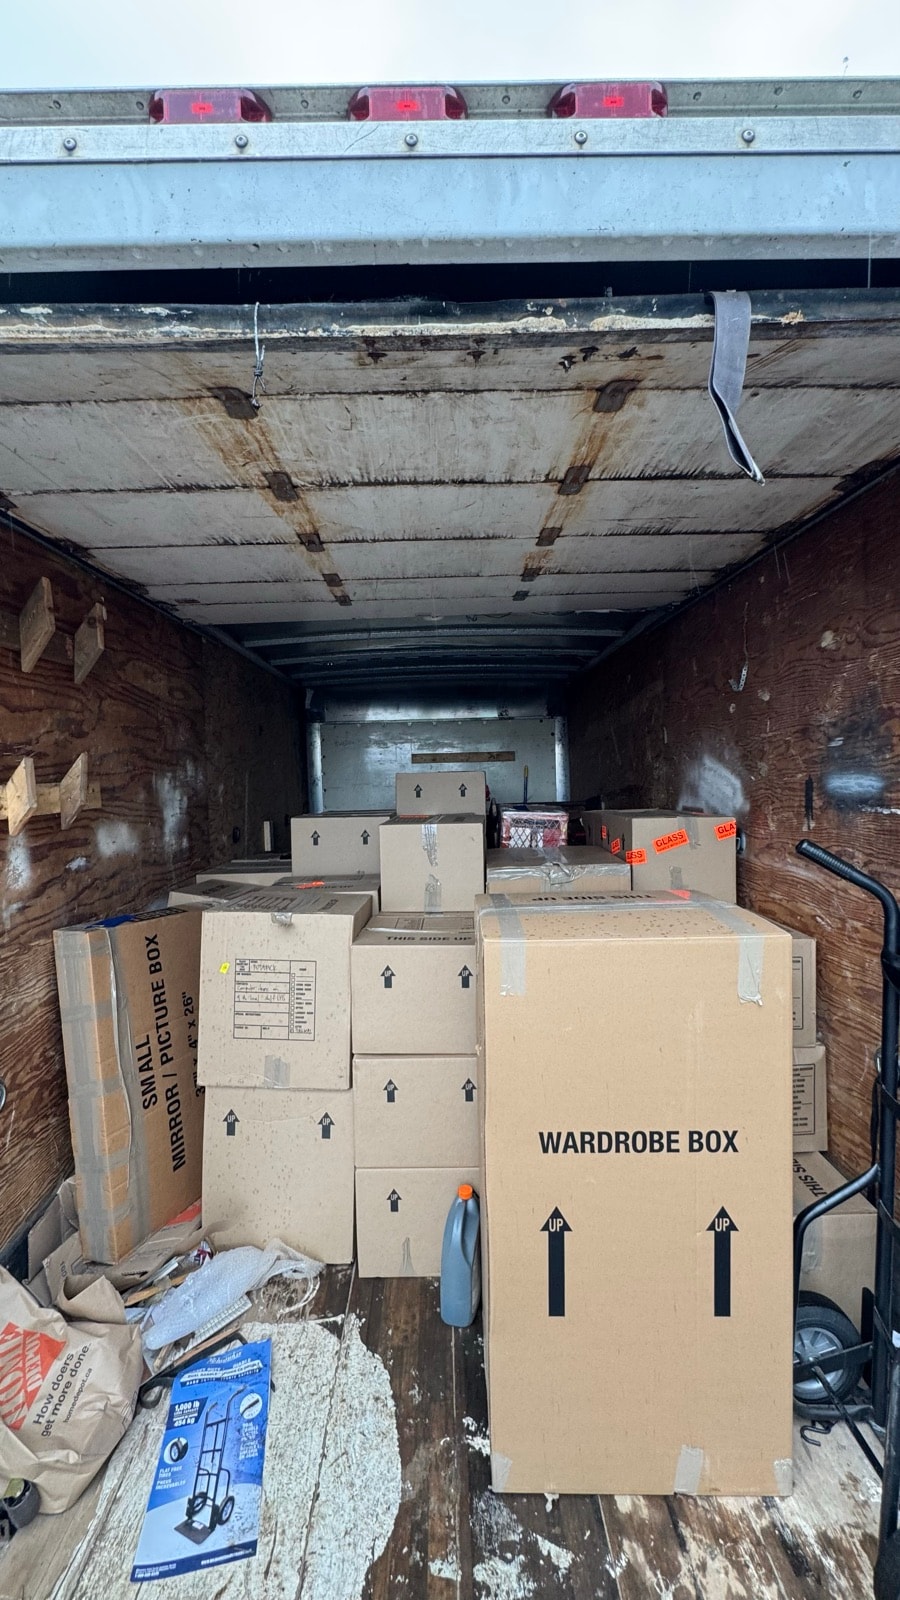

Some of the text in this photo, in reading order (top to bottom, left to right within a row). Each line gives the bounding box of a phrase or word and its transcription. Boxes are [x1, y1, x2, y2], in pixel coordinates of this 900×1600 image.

[717, 821, 736, 834] GLA
[655, 831, 684, 847] GLASS
[144, 933, 163, 975] BOX
[151, 978, 174, 1067] PICTURE
[135, 1034, 158, 1111] SMALL
[465, 1083, 473, 1091] UP
[165, 1082, 187, 1173] MIRROR
[227, 1115, 236, 1123] UP
[322, 1118, 331, 1126] UP
[538, 1130, 739, 1154] WARDROBE BOX
[798, 1175, 828, 1197] THIS
[548, 1218, 564, 1232] UP
[714, 1218, 730, 1232] UP
[33, 1352, 75, 1425] How doers
[62, 1367, 93, 1423] homedepot.ca
[41, 1419, 55, 1438] get
[51, 1380, 72, 1416] more
[175, 1400, 200, 1411] 1,000 lb
[173, 1419, 186, 1427] 454
